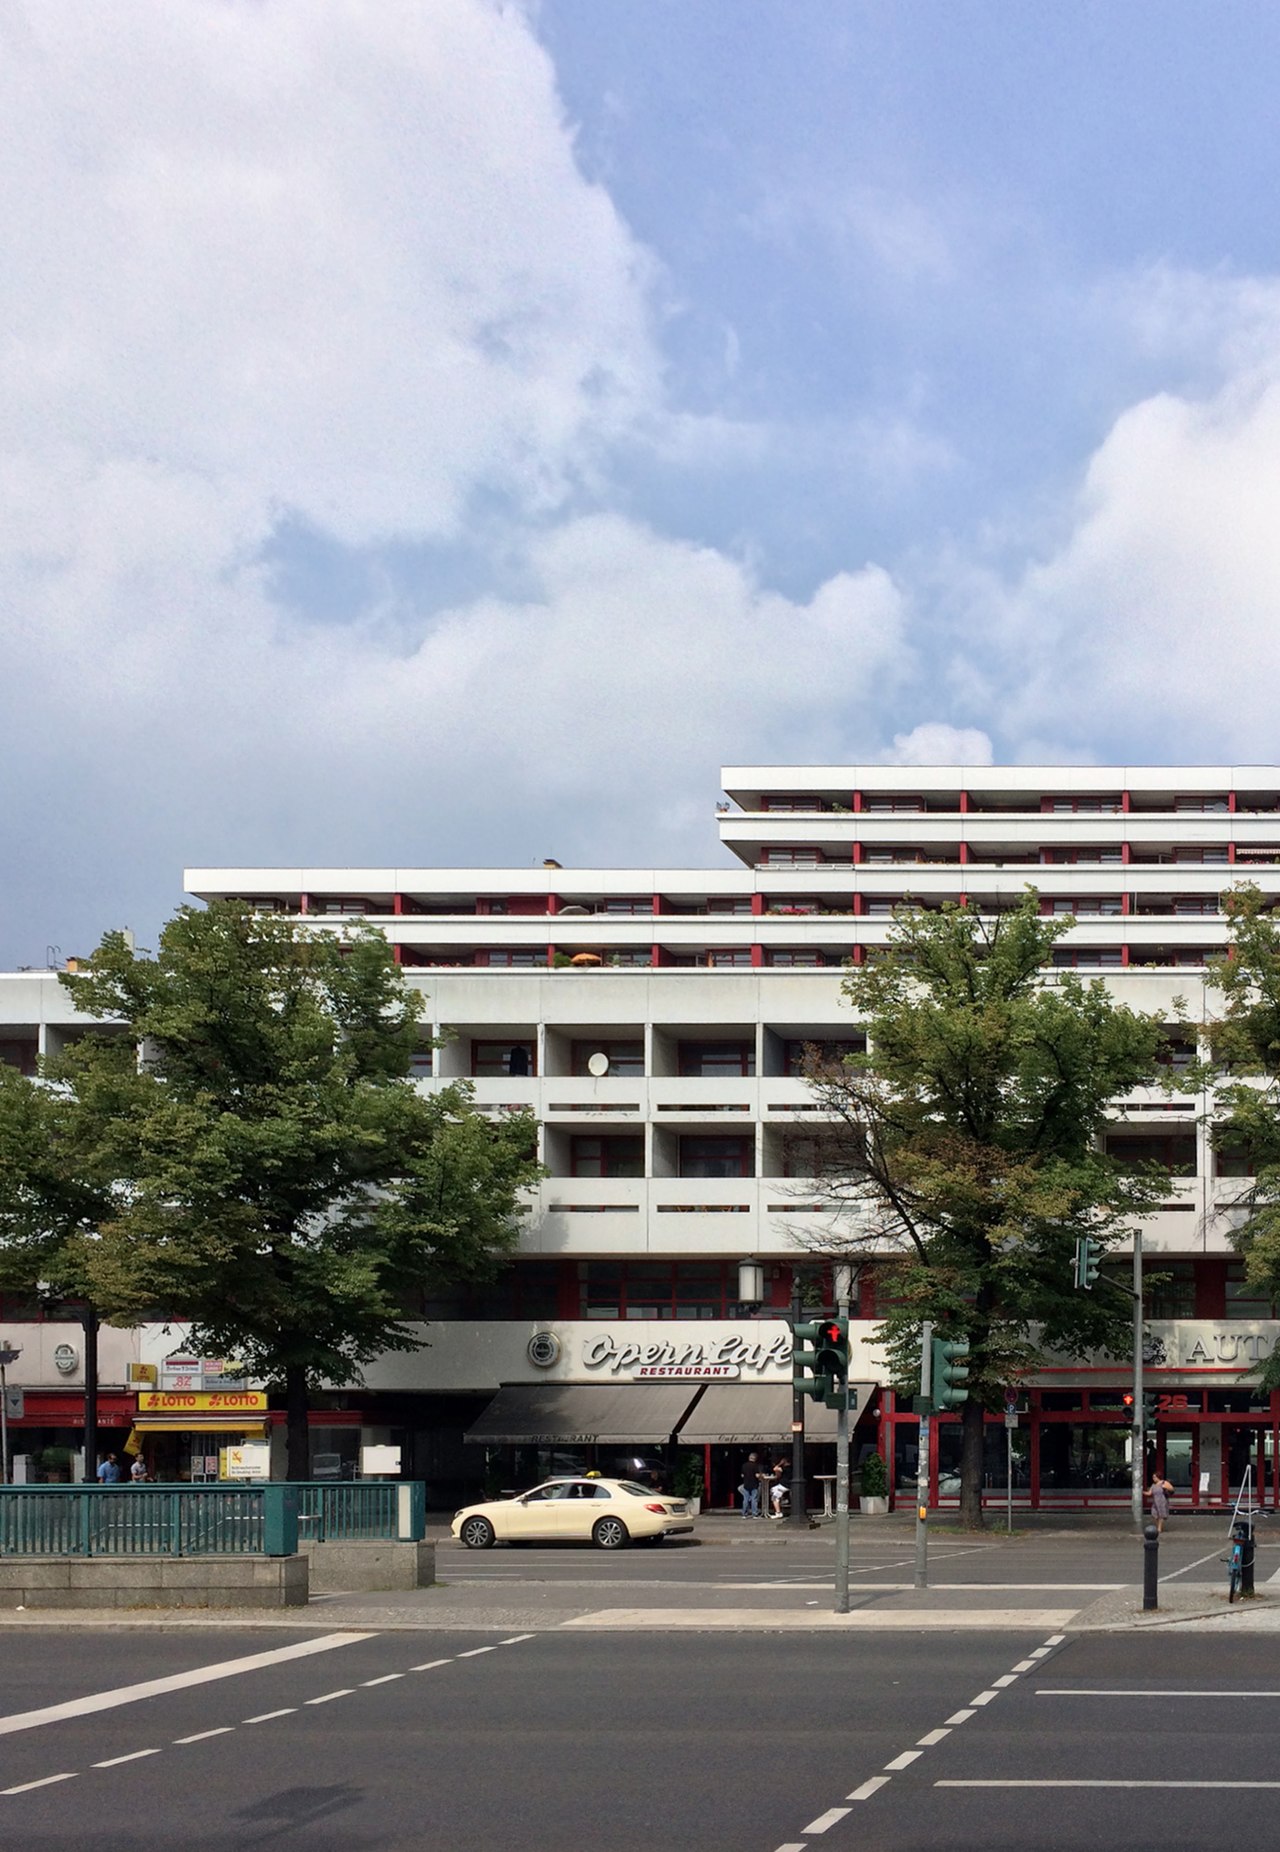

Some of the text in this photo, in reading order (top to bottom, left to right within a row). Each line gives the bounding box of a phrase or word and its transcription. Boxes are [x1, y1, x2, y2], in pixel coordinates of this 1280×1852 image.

[640, 1367, 730, 1376] RESTAURANT
[162, 1394, 196, 1407] LOTTO
[224, 1394, 259, 1407] LOTTO
